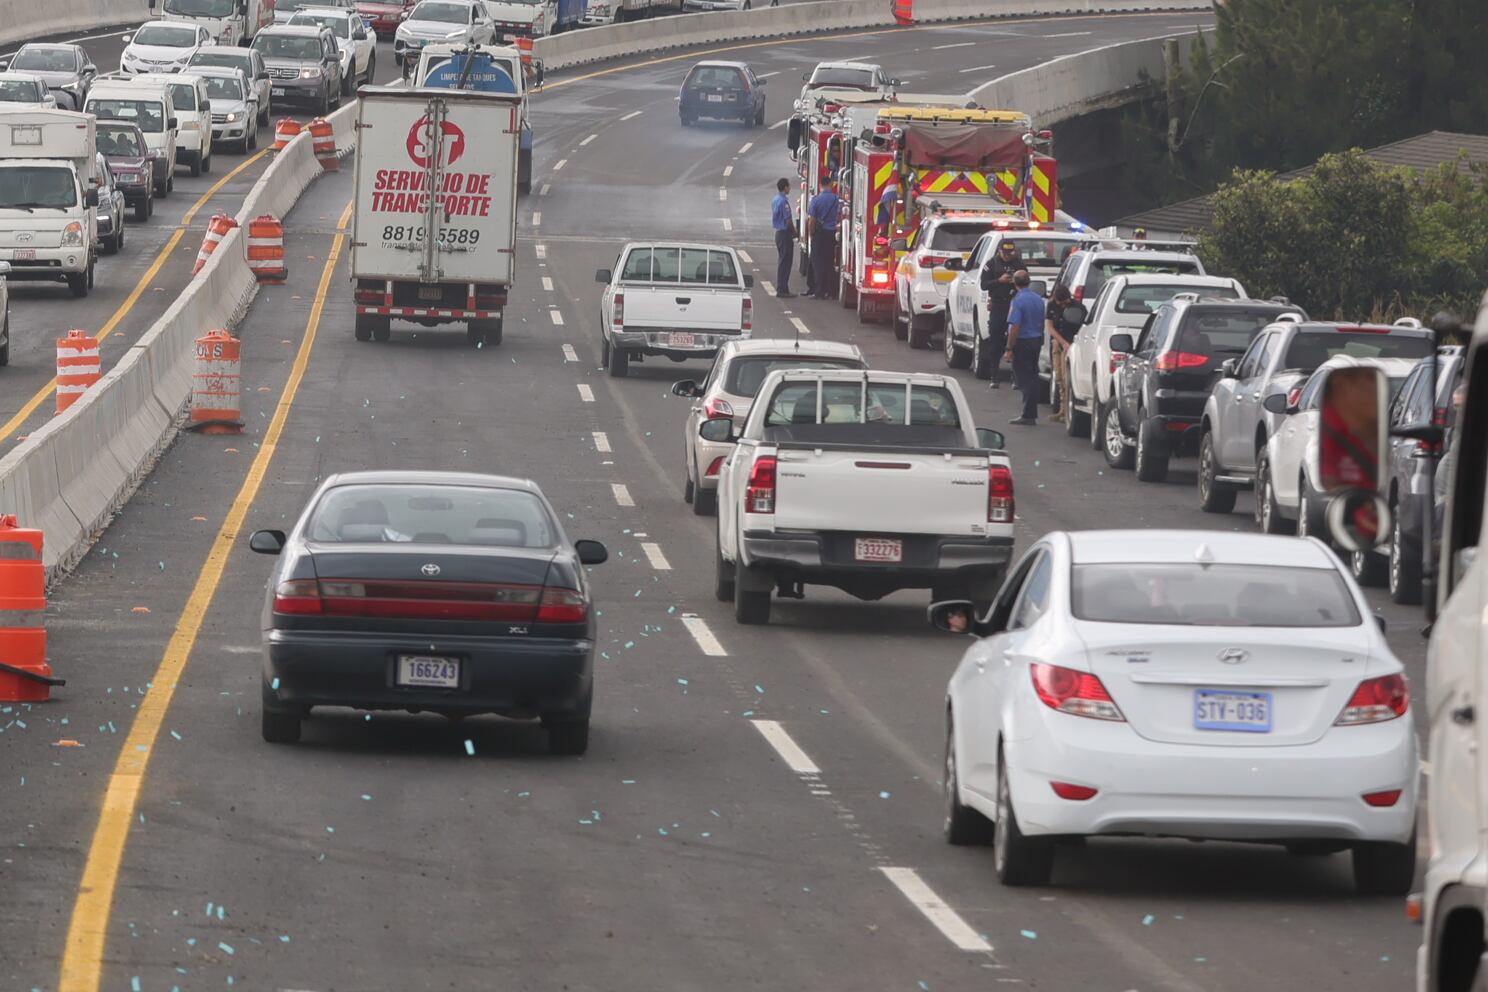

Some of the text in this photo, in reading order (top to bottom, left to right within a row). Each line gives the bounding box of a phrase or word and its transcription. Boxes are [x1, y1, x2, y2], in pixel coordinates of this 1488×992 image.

[466, 174, 491, 195] DE
[382, 225, 480, 245] 88195589
[409, 662, 456, 680] 166243
[1199, 701, 1265, 720] STV-036
